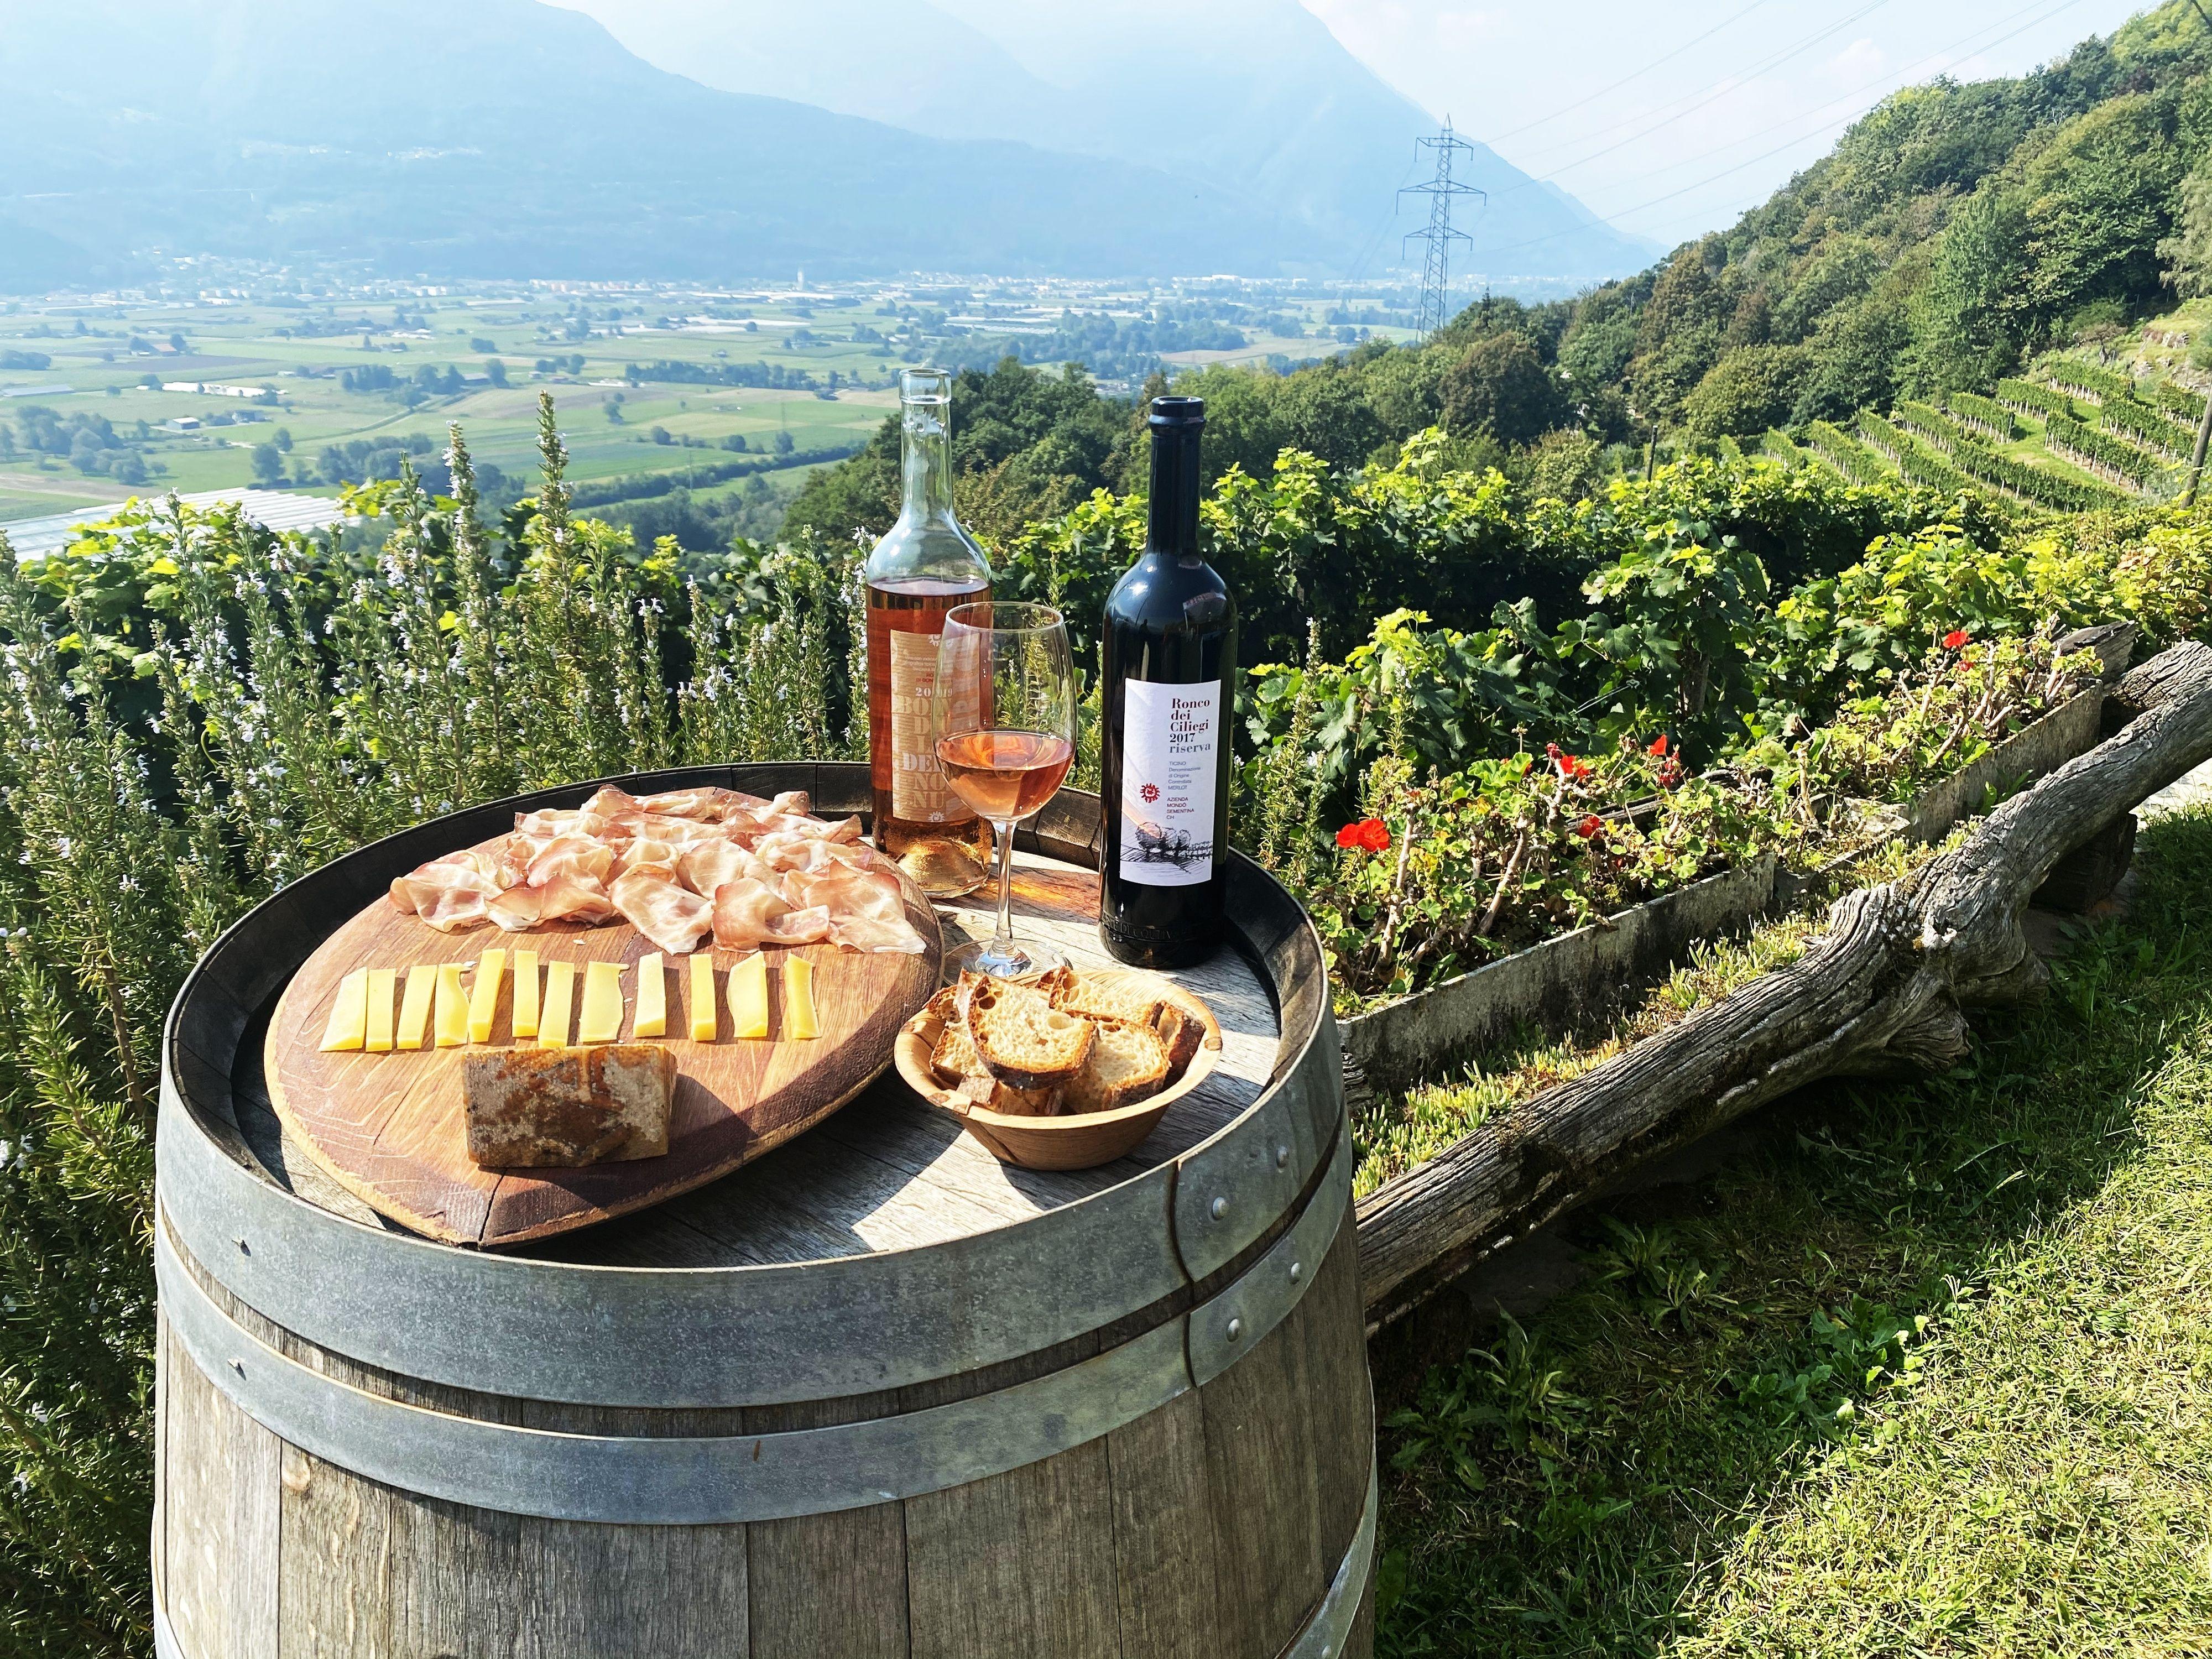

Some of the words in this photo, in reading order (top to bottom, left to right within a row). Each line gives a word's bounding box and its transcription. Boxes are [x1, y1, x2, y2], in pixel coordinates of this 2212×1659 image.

[1172, 698, 1210, 709] Ronco
[1171, 709, 1190, 721] dei
[1170, 719, 1209, 733] Ciliegi
[1170, 733, 1196, 743] 2017
[1169, 743, 1211, 753] riserva
